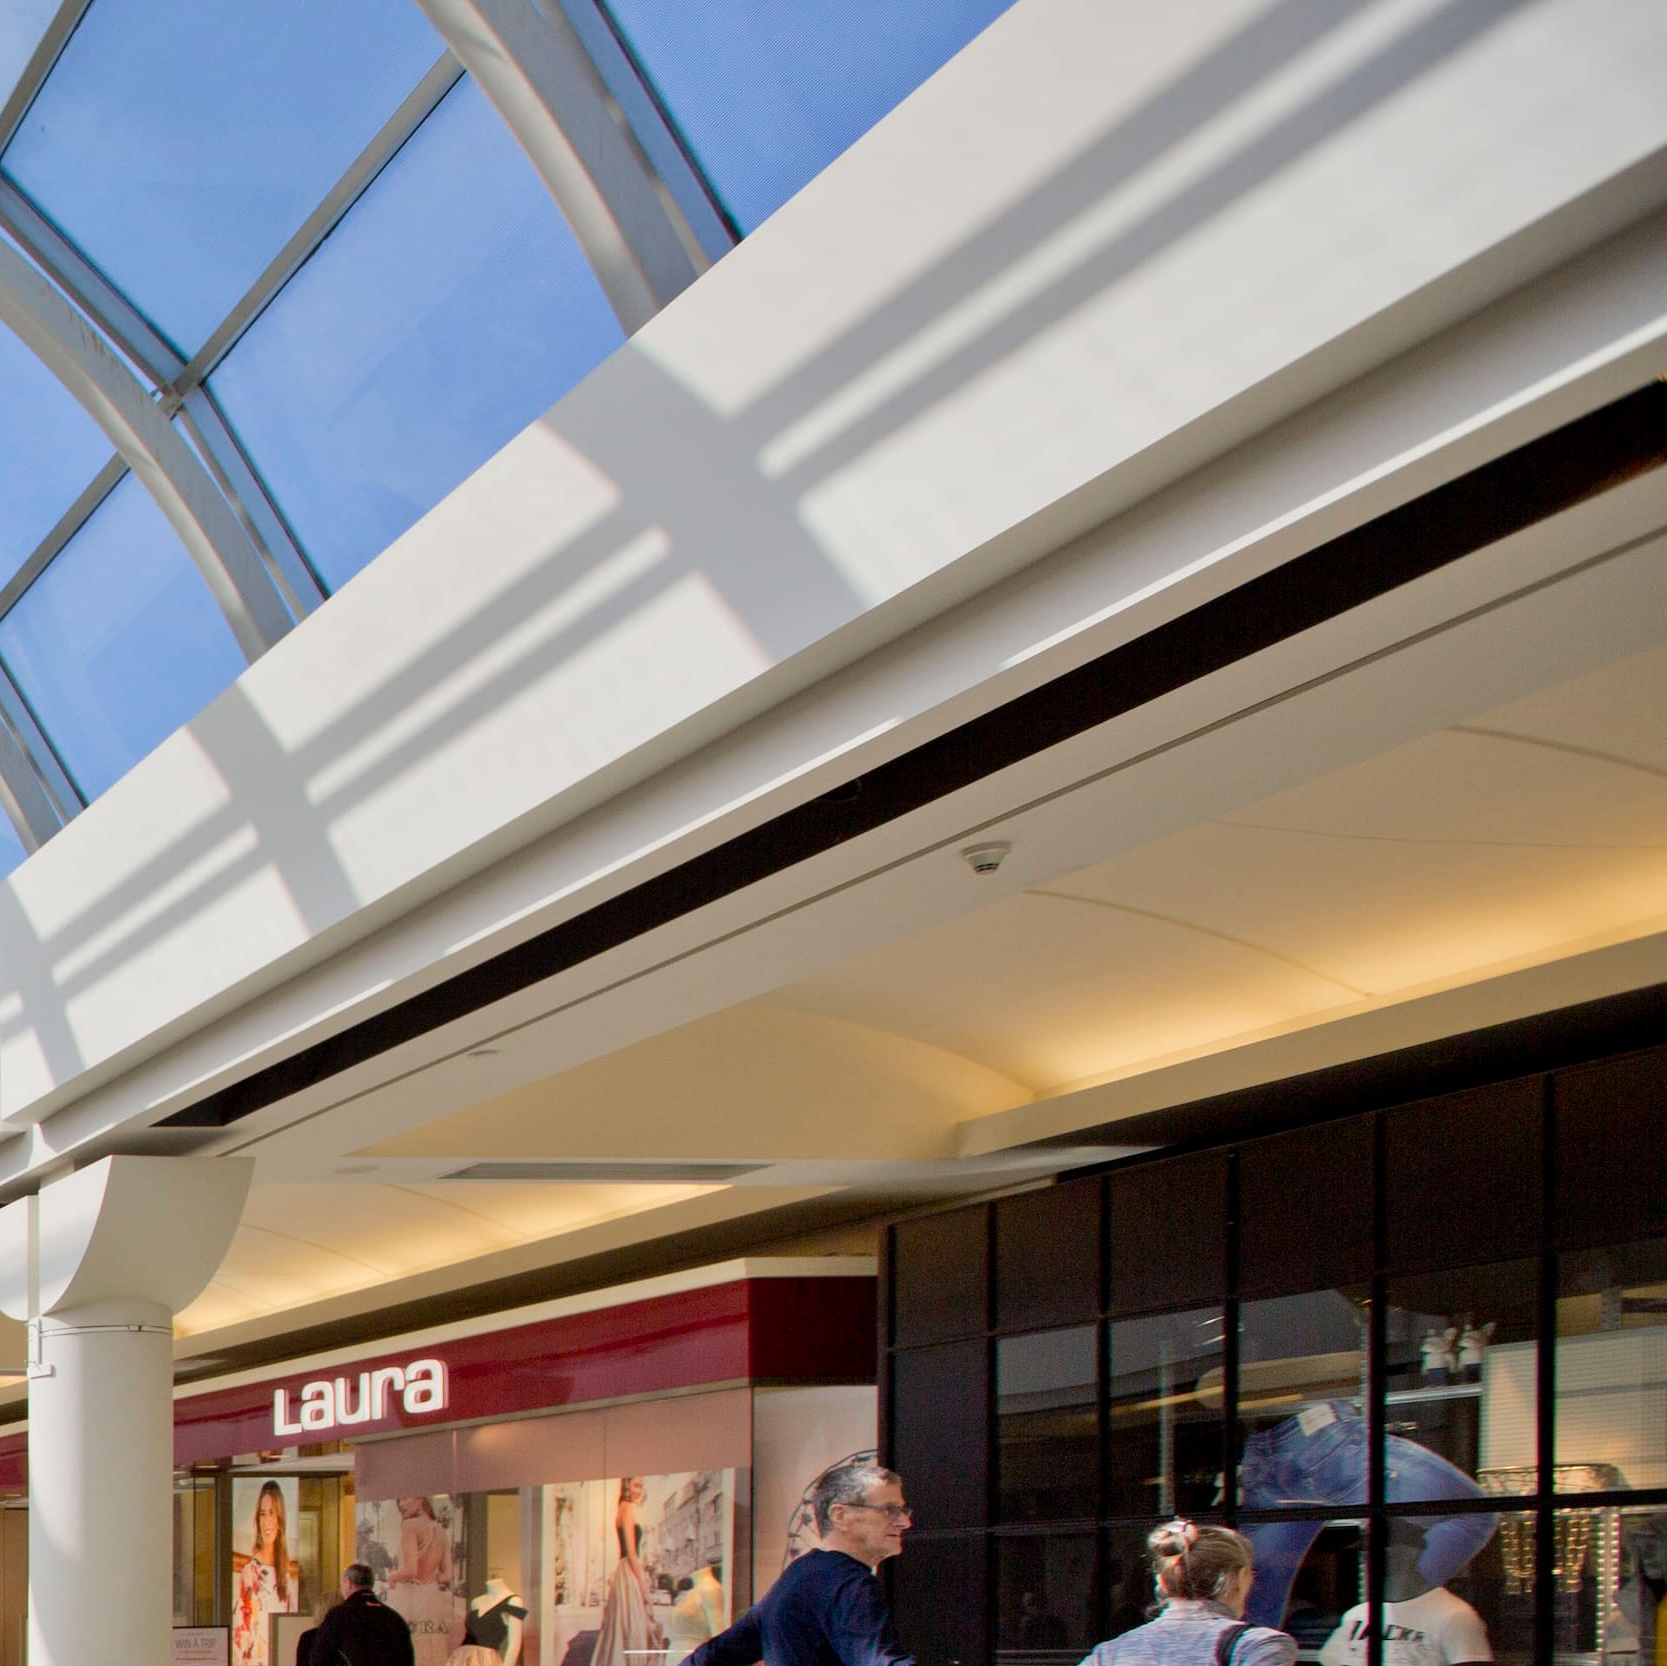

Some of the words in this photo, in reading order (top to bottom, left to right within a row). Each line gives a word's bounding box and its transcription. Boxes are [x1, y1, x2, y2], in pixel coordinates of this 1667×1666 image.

[273, 1358, 448, 1436] Laura
[175, 1638, 192, 1649] WIN
[193, 1638, 200, 1648] A
